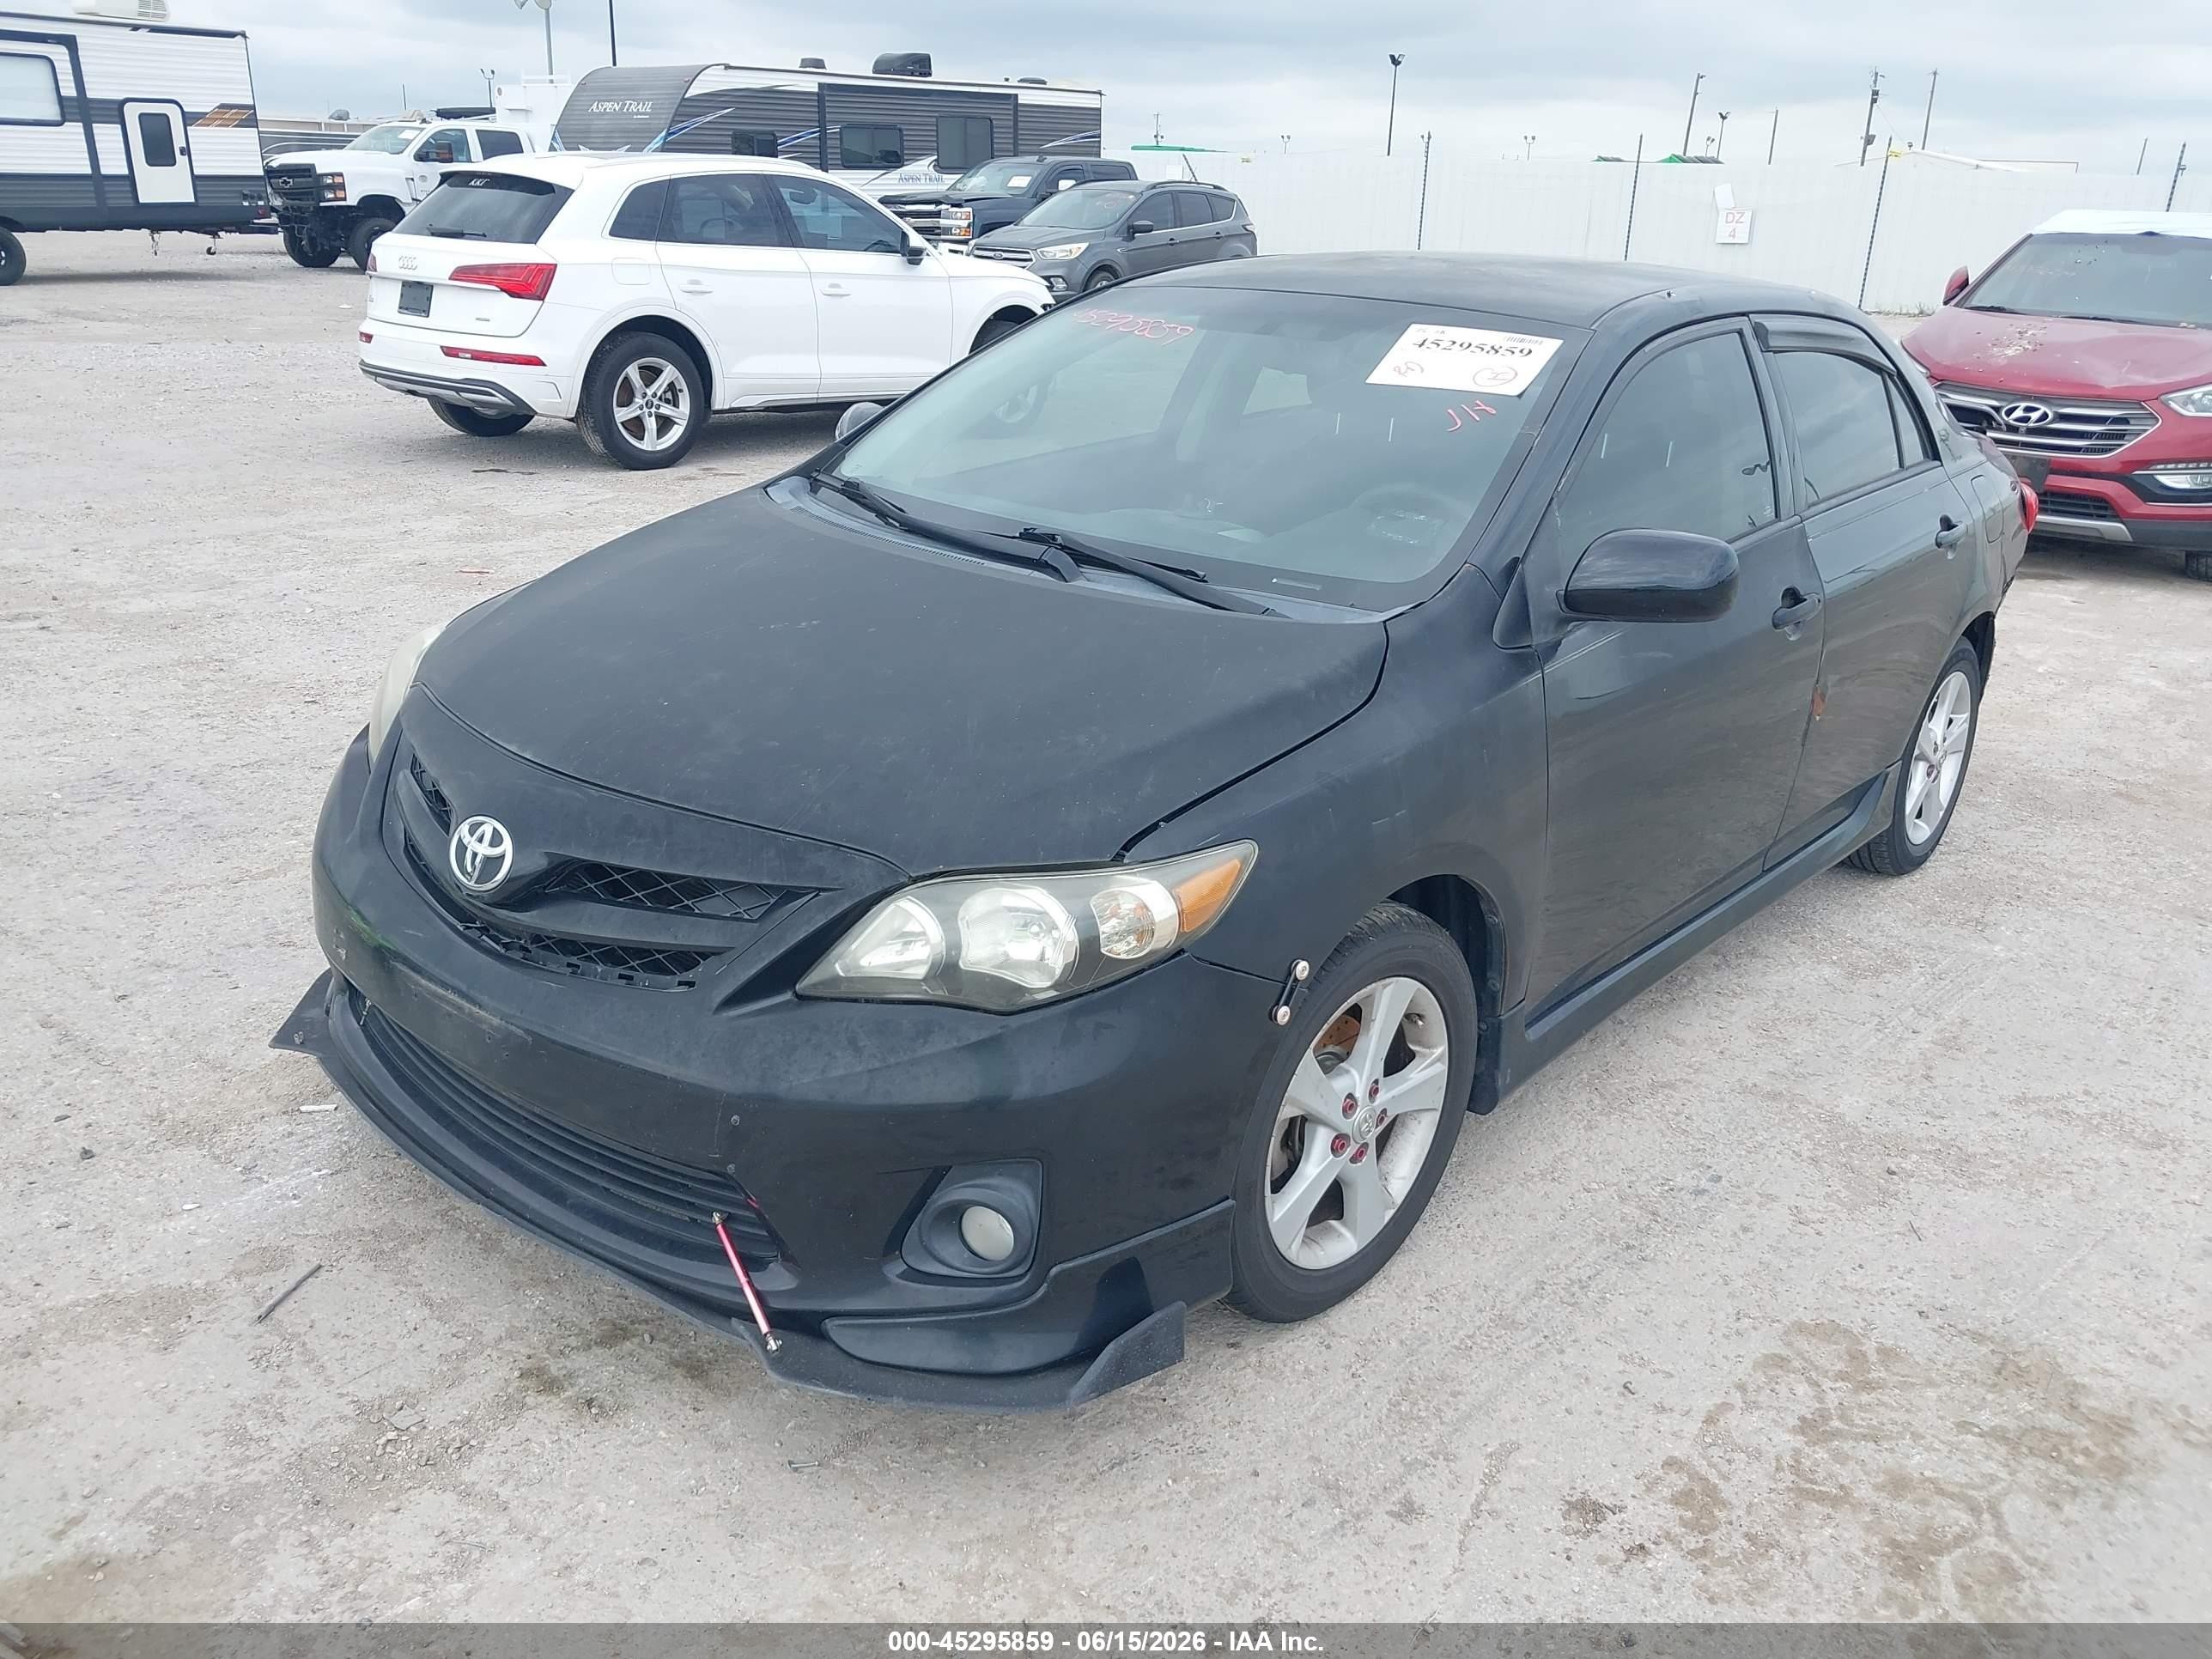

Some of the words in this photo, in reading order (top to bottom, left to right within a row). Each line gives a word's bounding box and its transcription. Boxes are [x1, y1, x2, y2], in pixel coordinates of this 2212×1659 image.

[587, 100, 623, 112] ASPEN
[623, 100, 653, 112] TRAIL
[898, 173, 921, 184] ASPEN
[922, 173, 944, 183] TRAIL
[1725, 211, 1746, 224] DZ
[1729, 227, 1737, 240] 4
[1413, 337, 1534, 357] 45295859
